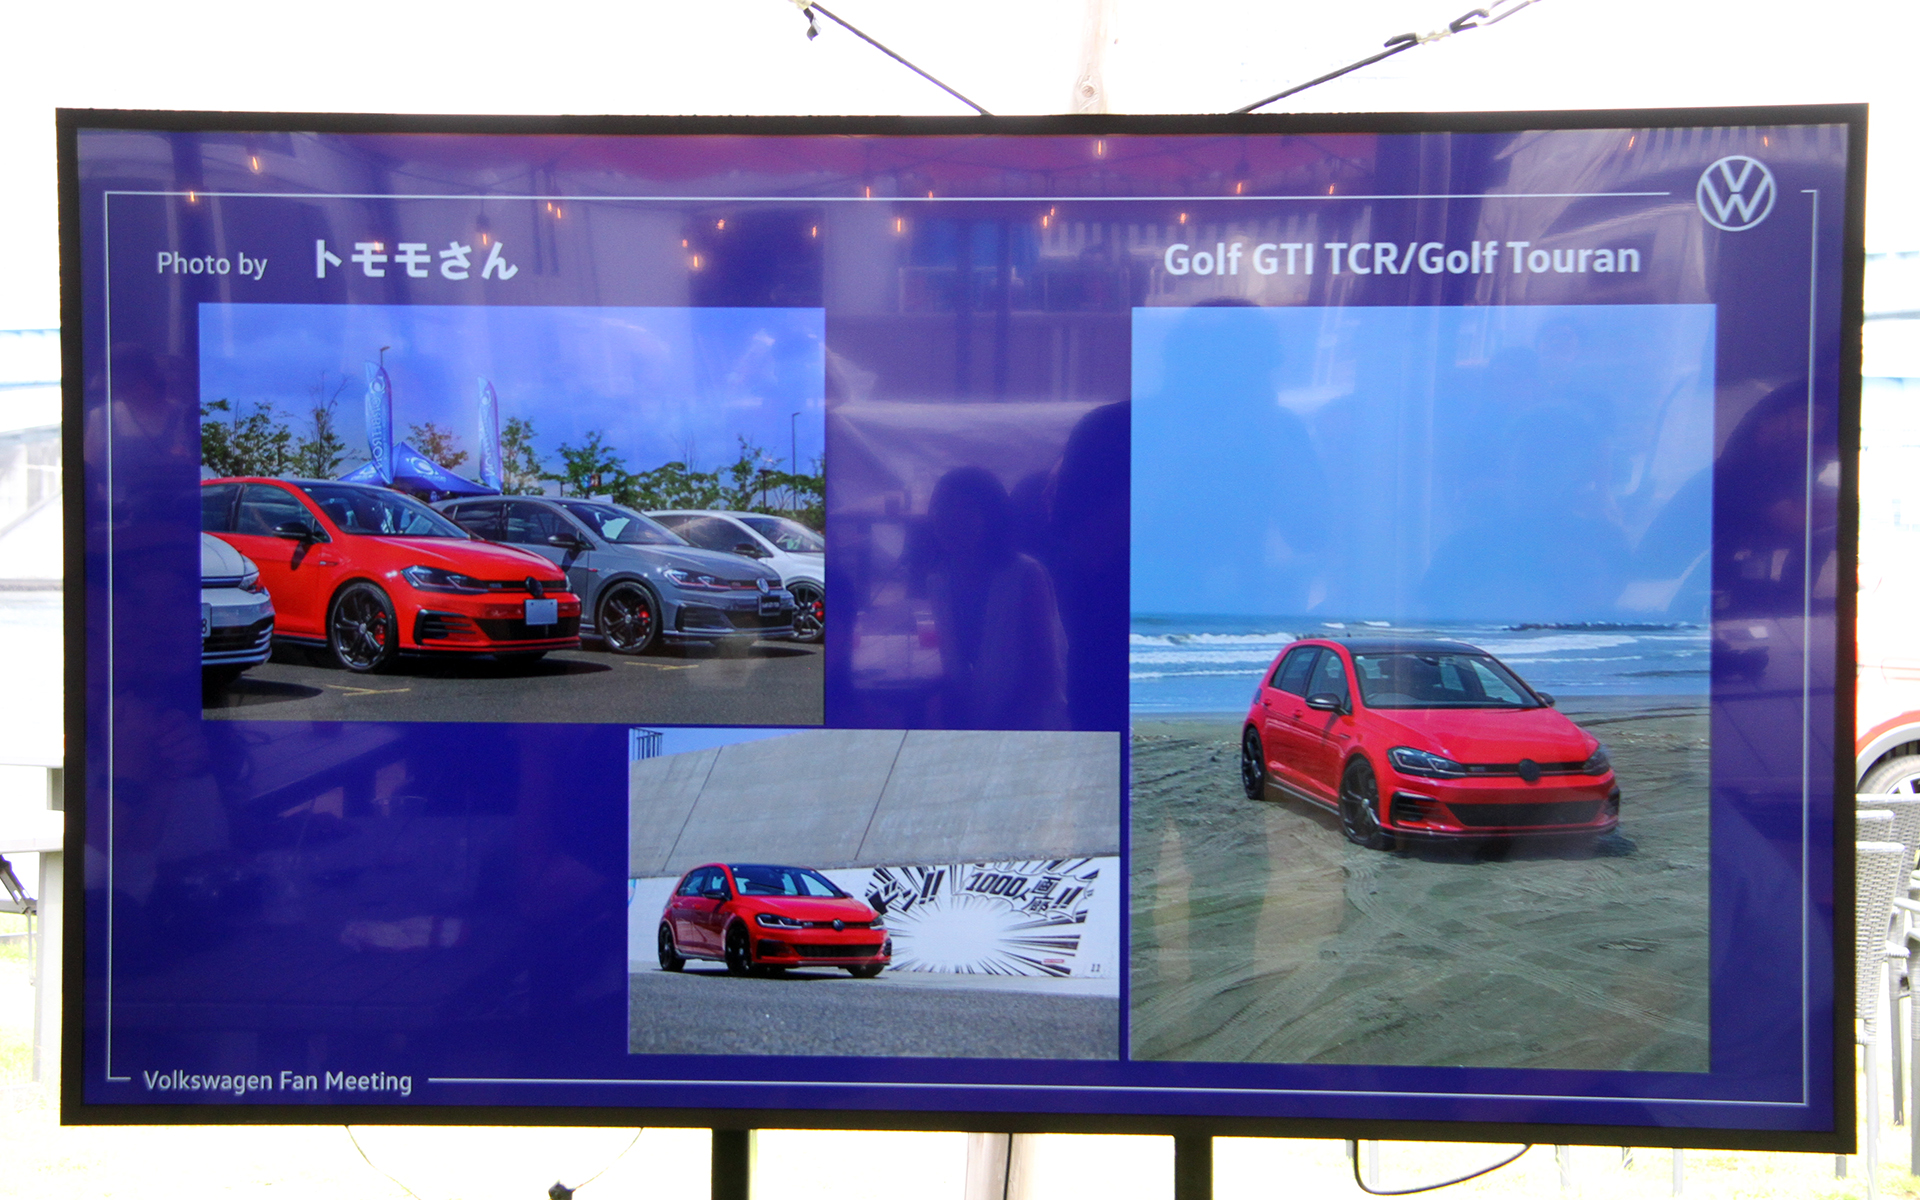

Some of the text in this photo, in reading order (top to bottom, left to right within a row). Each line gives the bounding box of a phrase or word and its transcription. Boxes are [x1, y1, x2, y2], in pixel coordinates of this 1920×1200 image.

[157, 251, 268, 281] Photo by
[315, 239, 519, 281] トモモさん
[1164, 240, 1641, 276] Golf GTI TCR/Golf Touran
[143, 1070, 413, 1096] Volkswagen Fan Meeting
